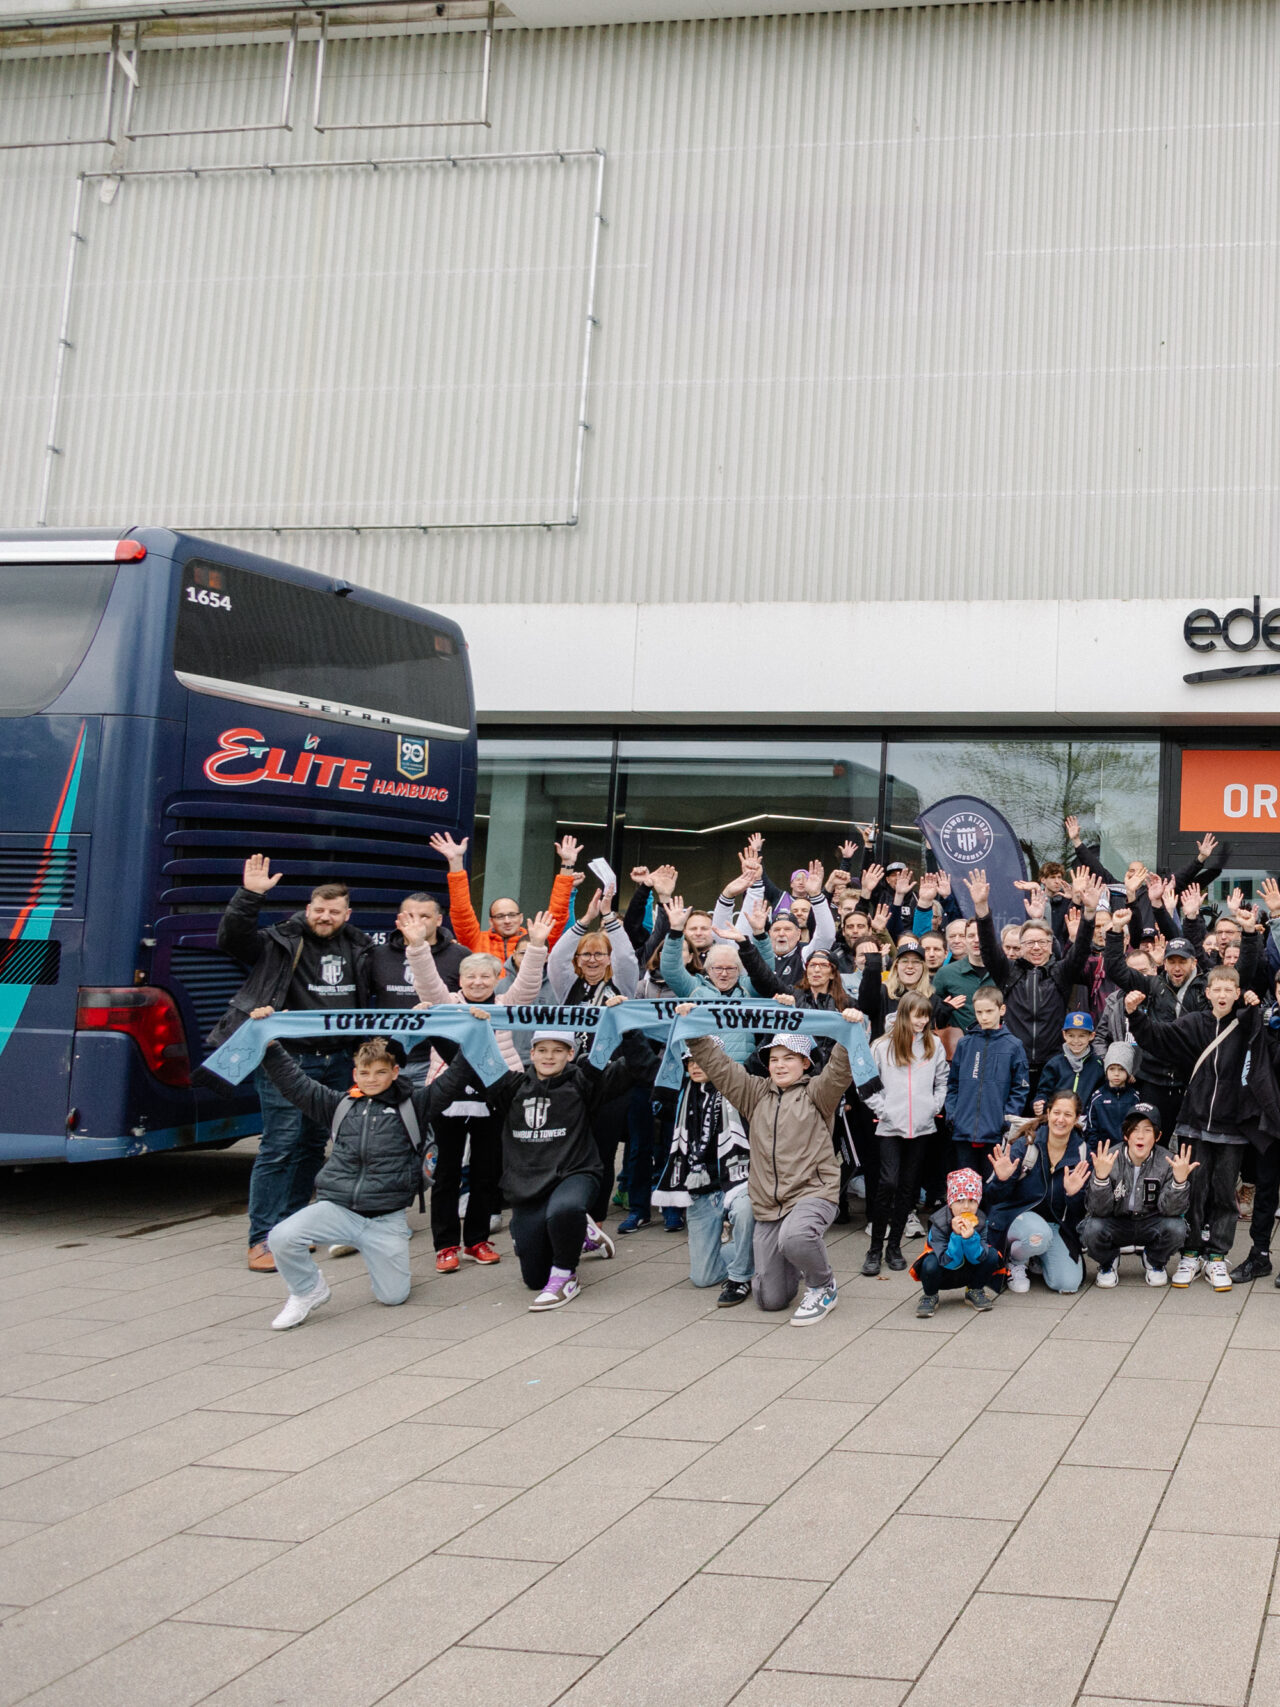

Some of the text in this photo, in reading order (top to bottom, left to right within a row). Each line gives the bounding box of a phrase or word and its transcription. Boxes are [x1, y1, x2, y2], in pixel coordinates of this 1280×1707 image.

[186, 586, 232, 611] 1654
[298, 701, 392, 725] SETRA
[402, 742, 425, 763] 90
[372, 779, 449, 803] HAMBURG
[319, 1013, 431, 1031] TOWERS
[504, 1005, 600, 1027] TOWERS
[708, 1007, 804, 1031] TOWERS
